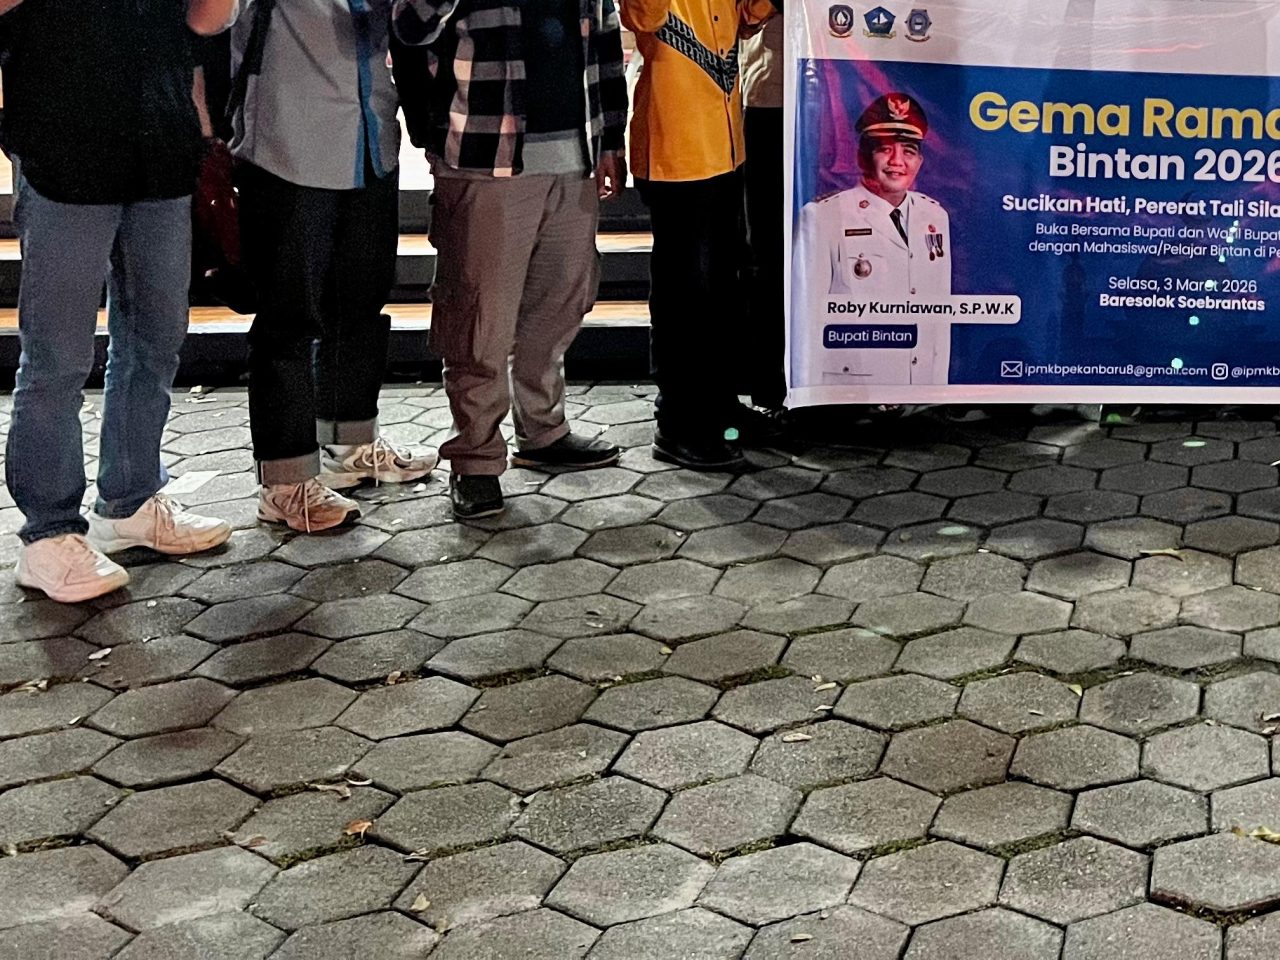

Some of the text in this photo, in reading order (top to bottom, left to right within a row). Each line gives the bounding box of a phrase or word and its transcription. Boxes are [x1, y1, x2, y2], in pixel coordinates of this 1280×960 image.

[968, 91, 1131, 136] Gema
[1049, 143, 1186, 181] Bintan
[1002, 194, 1082, 213] Sucikan
[1086, 196, 1131, 215] Hati,
[1135, 198, 1206, 216] Pererat
[1210, 198, 1244, 217] Tali
[1036, 223, 1068, 235] Buka
[1071, 224, 1130, 237] Bersama
[1133, 225, 1175, 240] Bupati
[1178, 226, 1204, 239] dan
[1207, 227, 1241, 239] Wail
[1029, 240, 1080, 256] dengan
[1083, 240, 1207, 259] Mahasiswa/Pelajar
[1211, 244, 1250, 257] Bintan
[1254, 246, 1266, 258] di
[1109, 276, 1160, 292] Selasa,
[1164, 277, 1172, 291] 3
[1222, 279, 1257, 293] 2026
[827, 301, 1015, 317] Roby Kurniawan, S.P.W.K
[1100, 293, 1265, 311] Baresolok Soebrantas
[828, 330, 912, 344] Bupati Bintan
